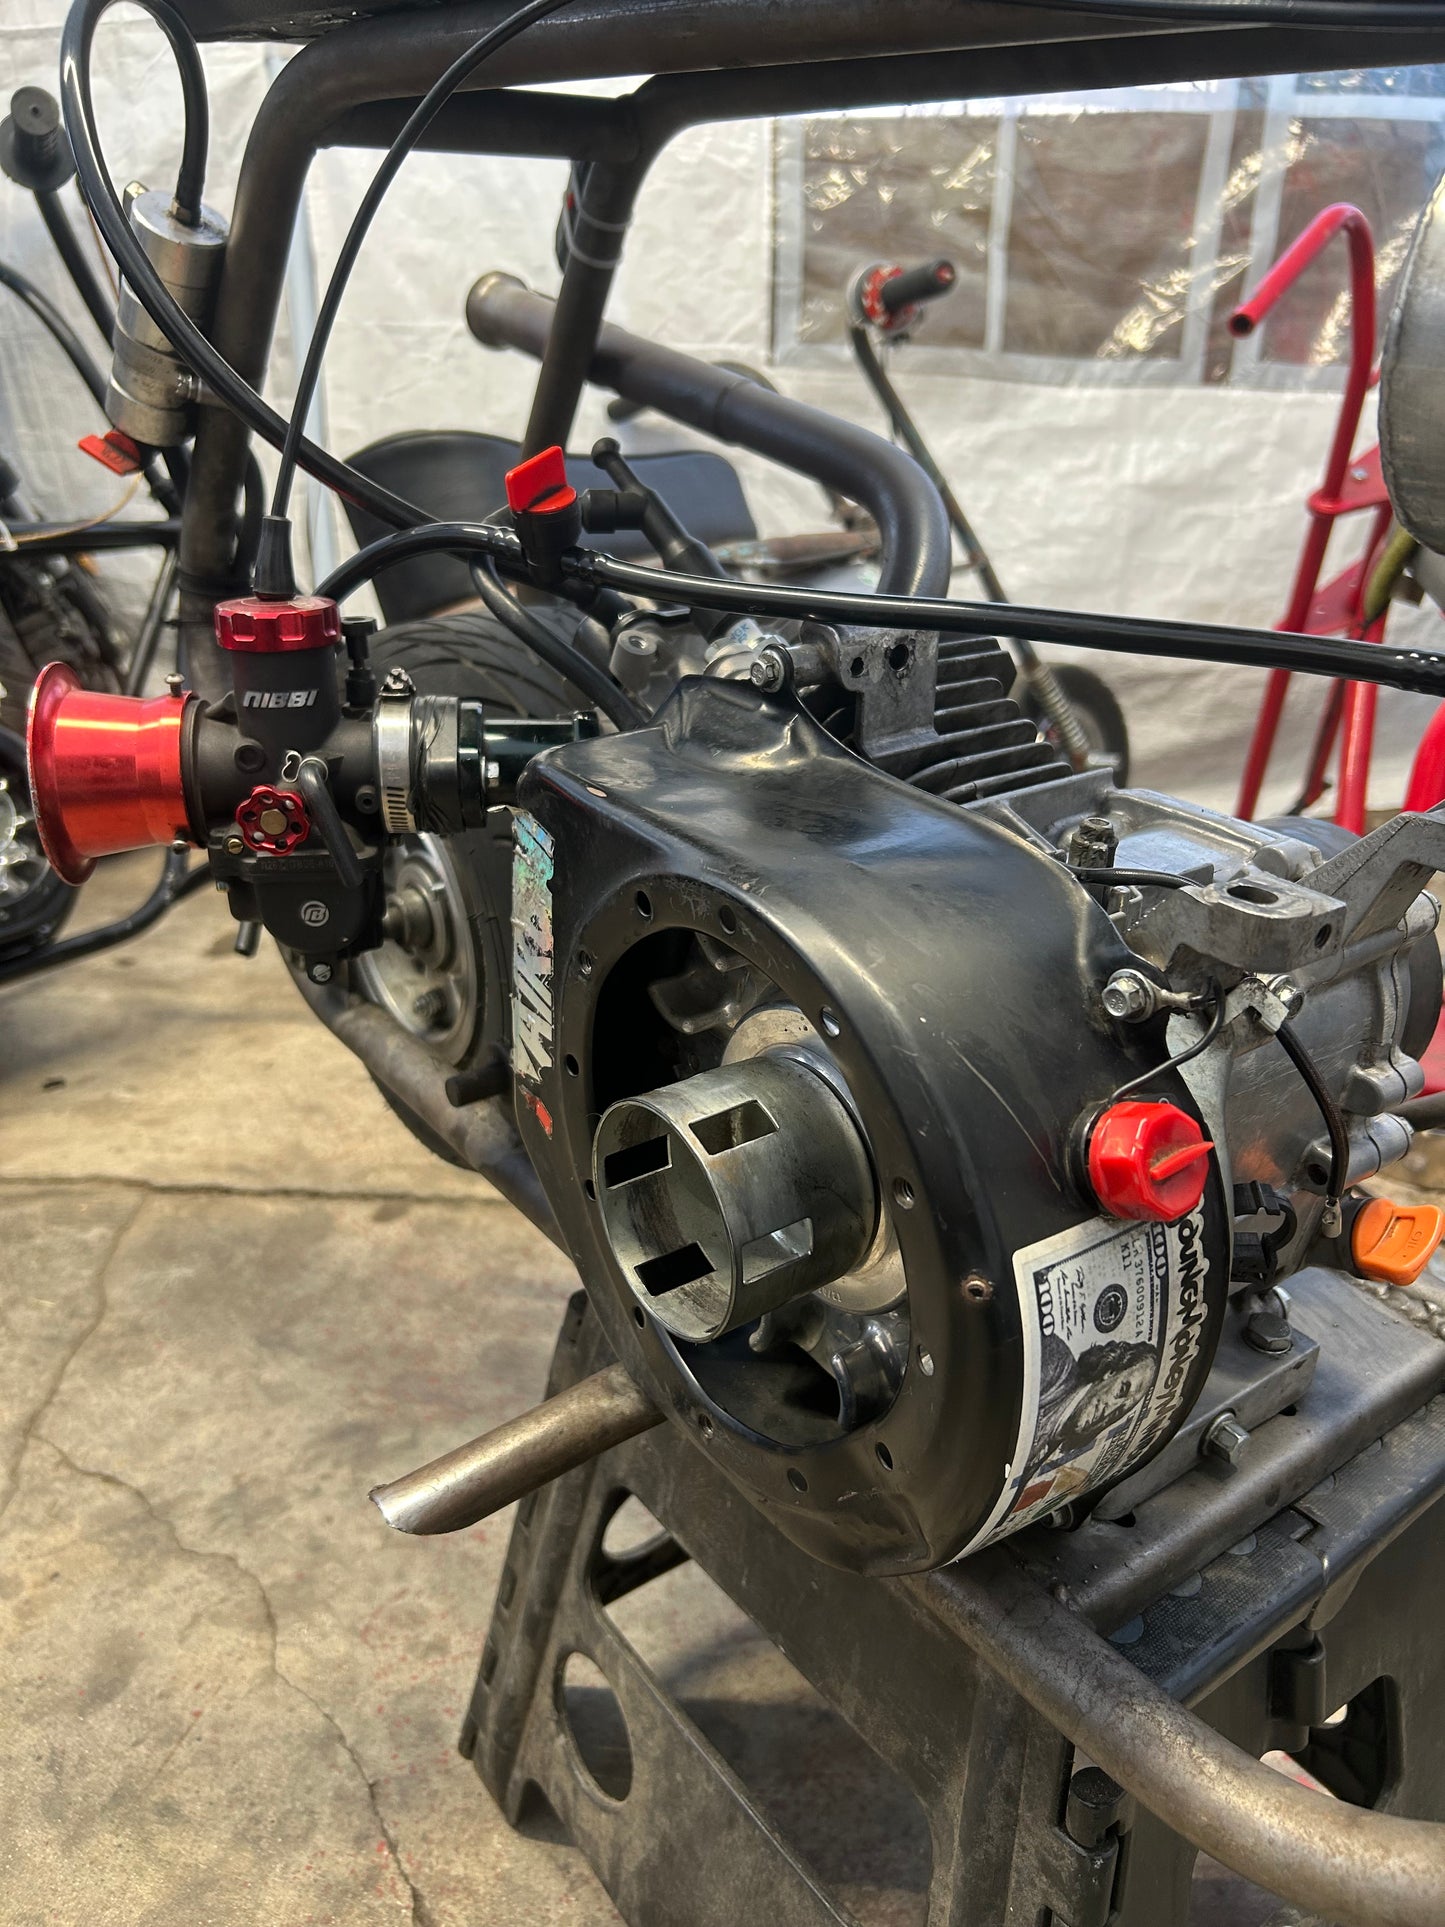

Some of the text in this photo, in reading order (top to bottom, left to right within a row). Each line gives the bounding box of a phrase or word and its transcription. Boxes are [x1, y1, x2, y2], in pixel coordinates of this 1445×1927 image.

[243, 690, 318, 708] NIBBI
[1120, 1242, 1132, 1271] K11
[1152, 1222, 1167, 1279] 100
[1038, 1281, 1055, 1337] 100
